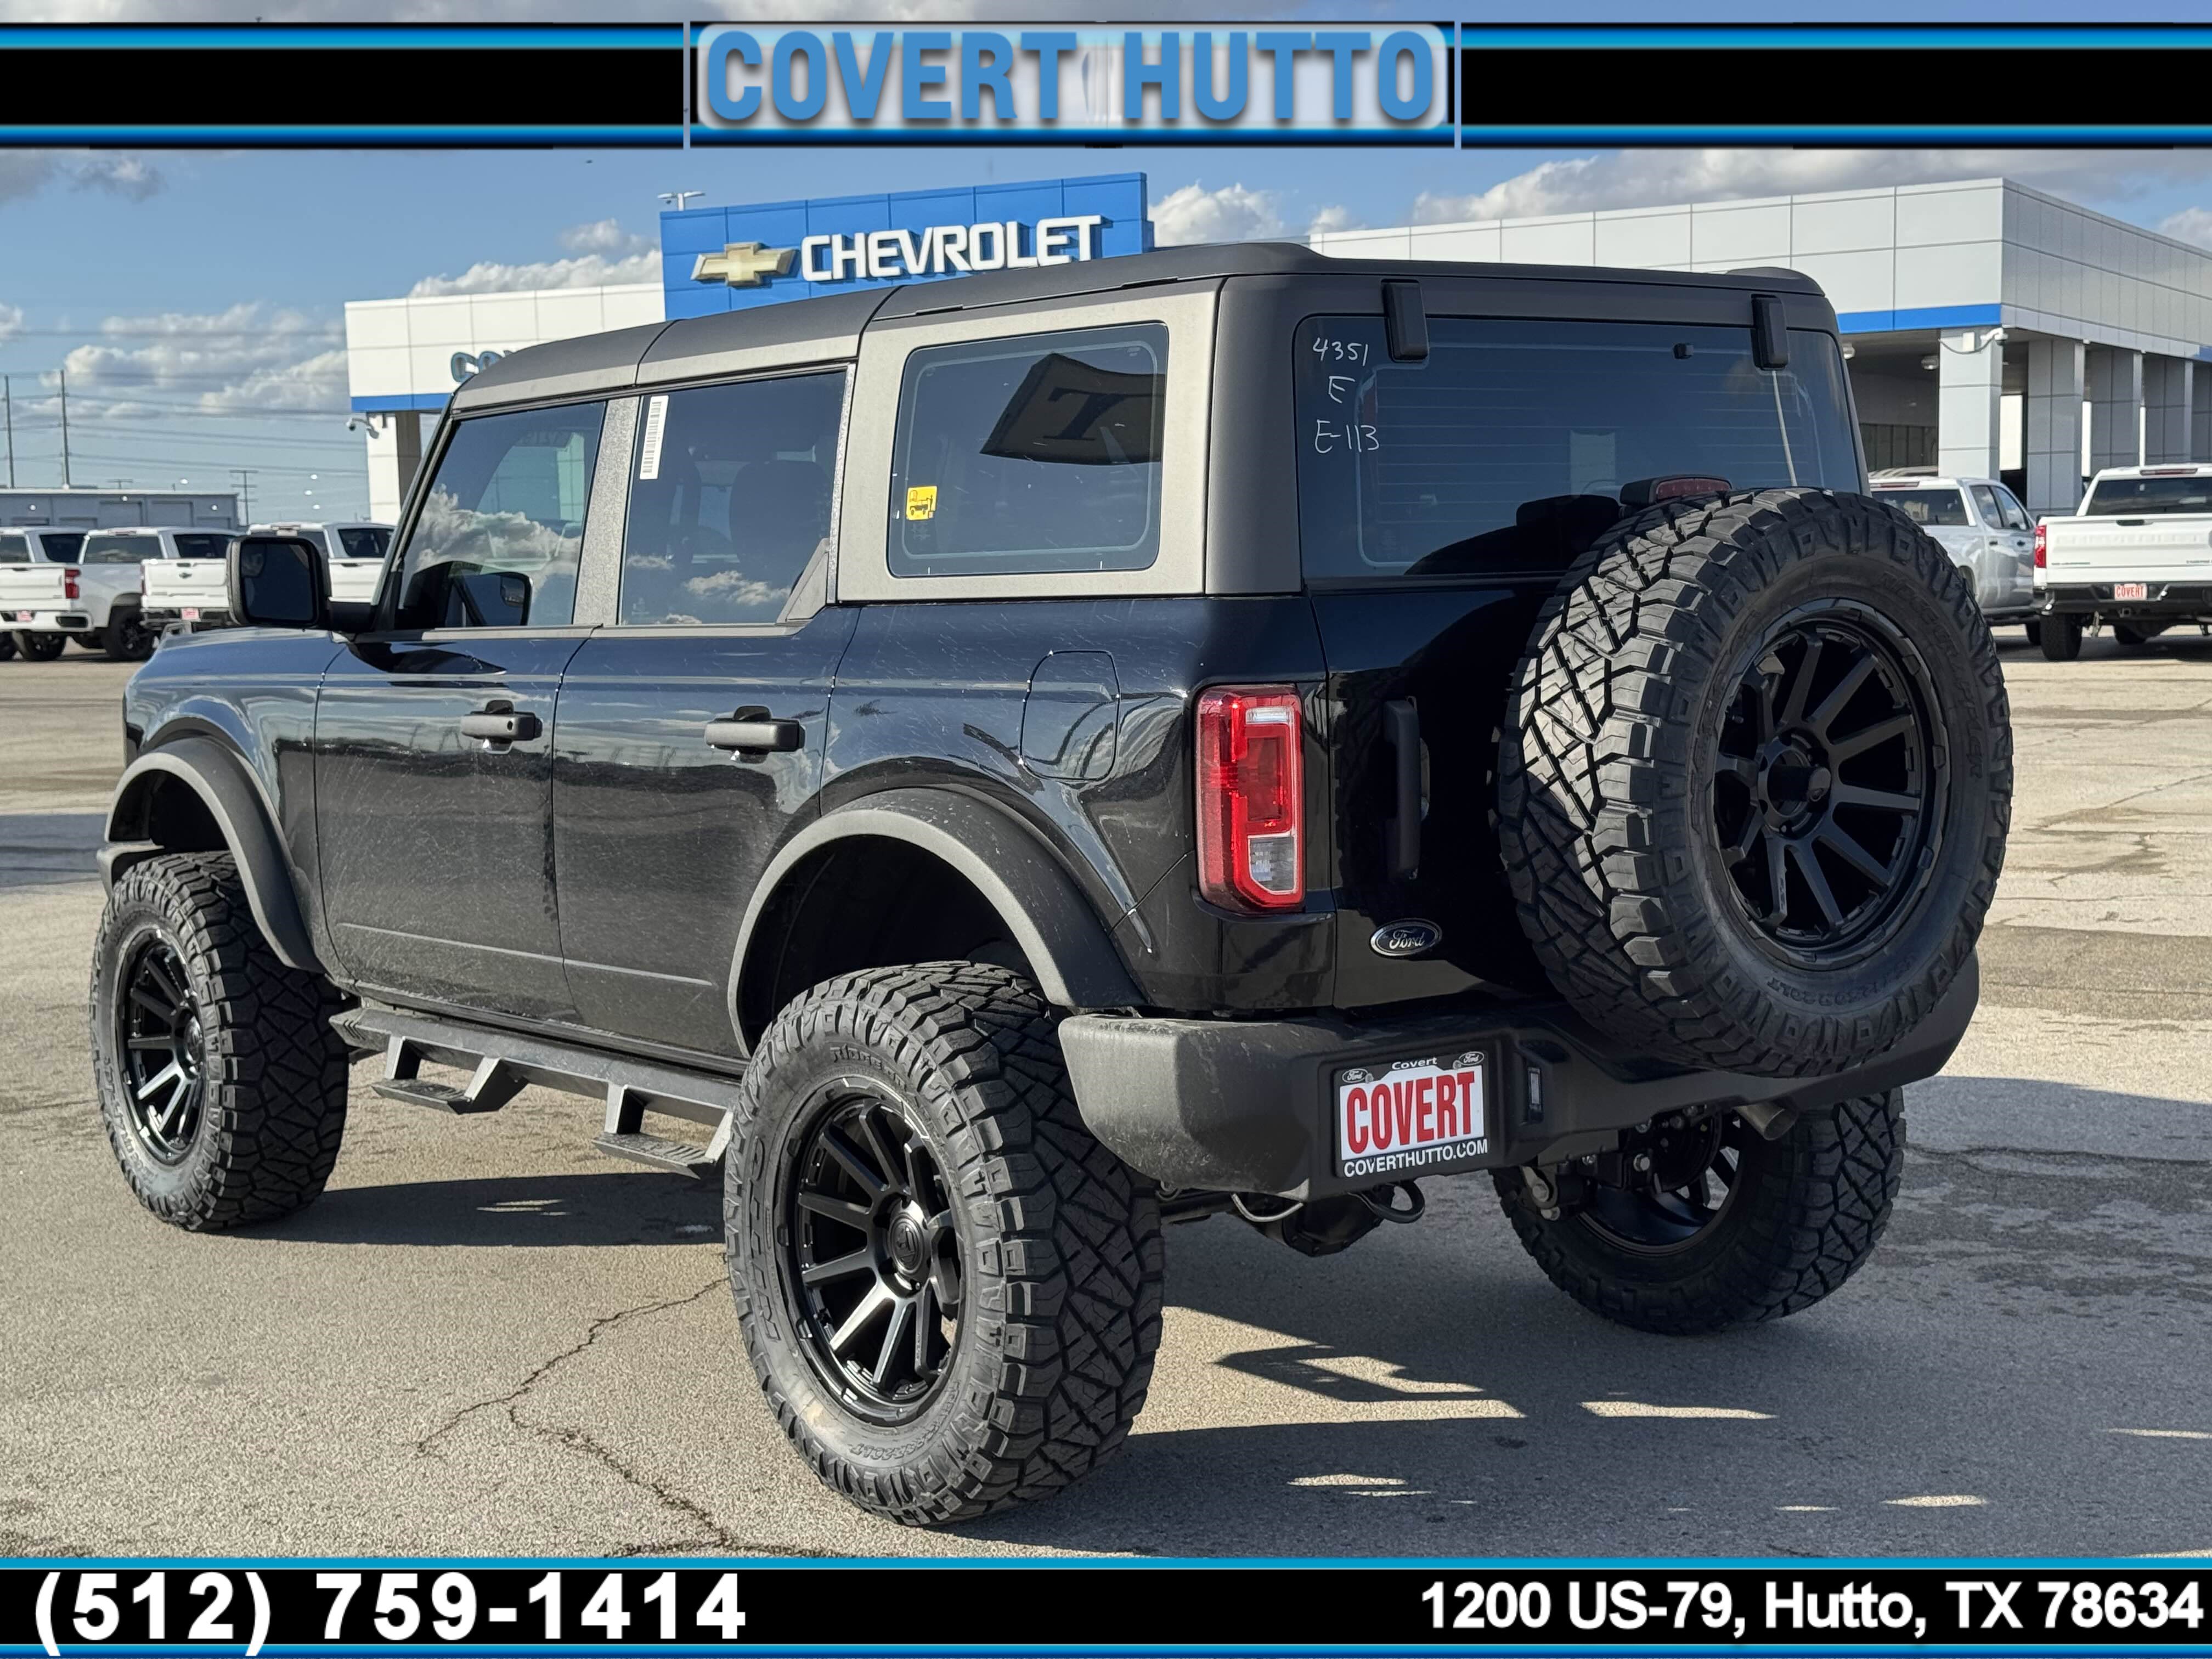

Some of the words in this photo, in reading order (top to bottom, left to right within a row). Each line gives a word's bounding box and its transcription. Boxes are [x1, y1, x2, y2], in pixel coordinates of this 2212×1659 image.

[801, 215, 1103, 282] CHEVROLET
[1312, 337, 1369, 366] 4351
[1328, 375, 1355, 403] E
[1389, 929, 1425, 949] Ford
[1392, 1057, 1437, 1070] Covert
[1347, 1071, 1475, 1154] COVERT
[1344, 1138, 1488, 1177] COVERTHUTTO.COM
